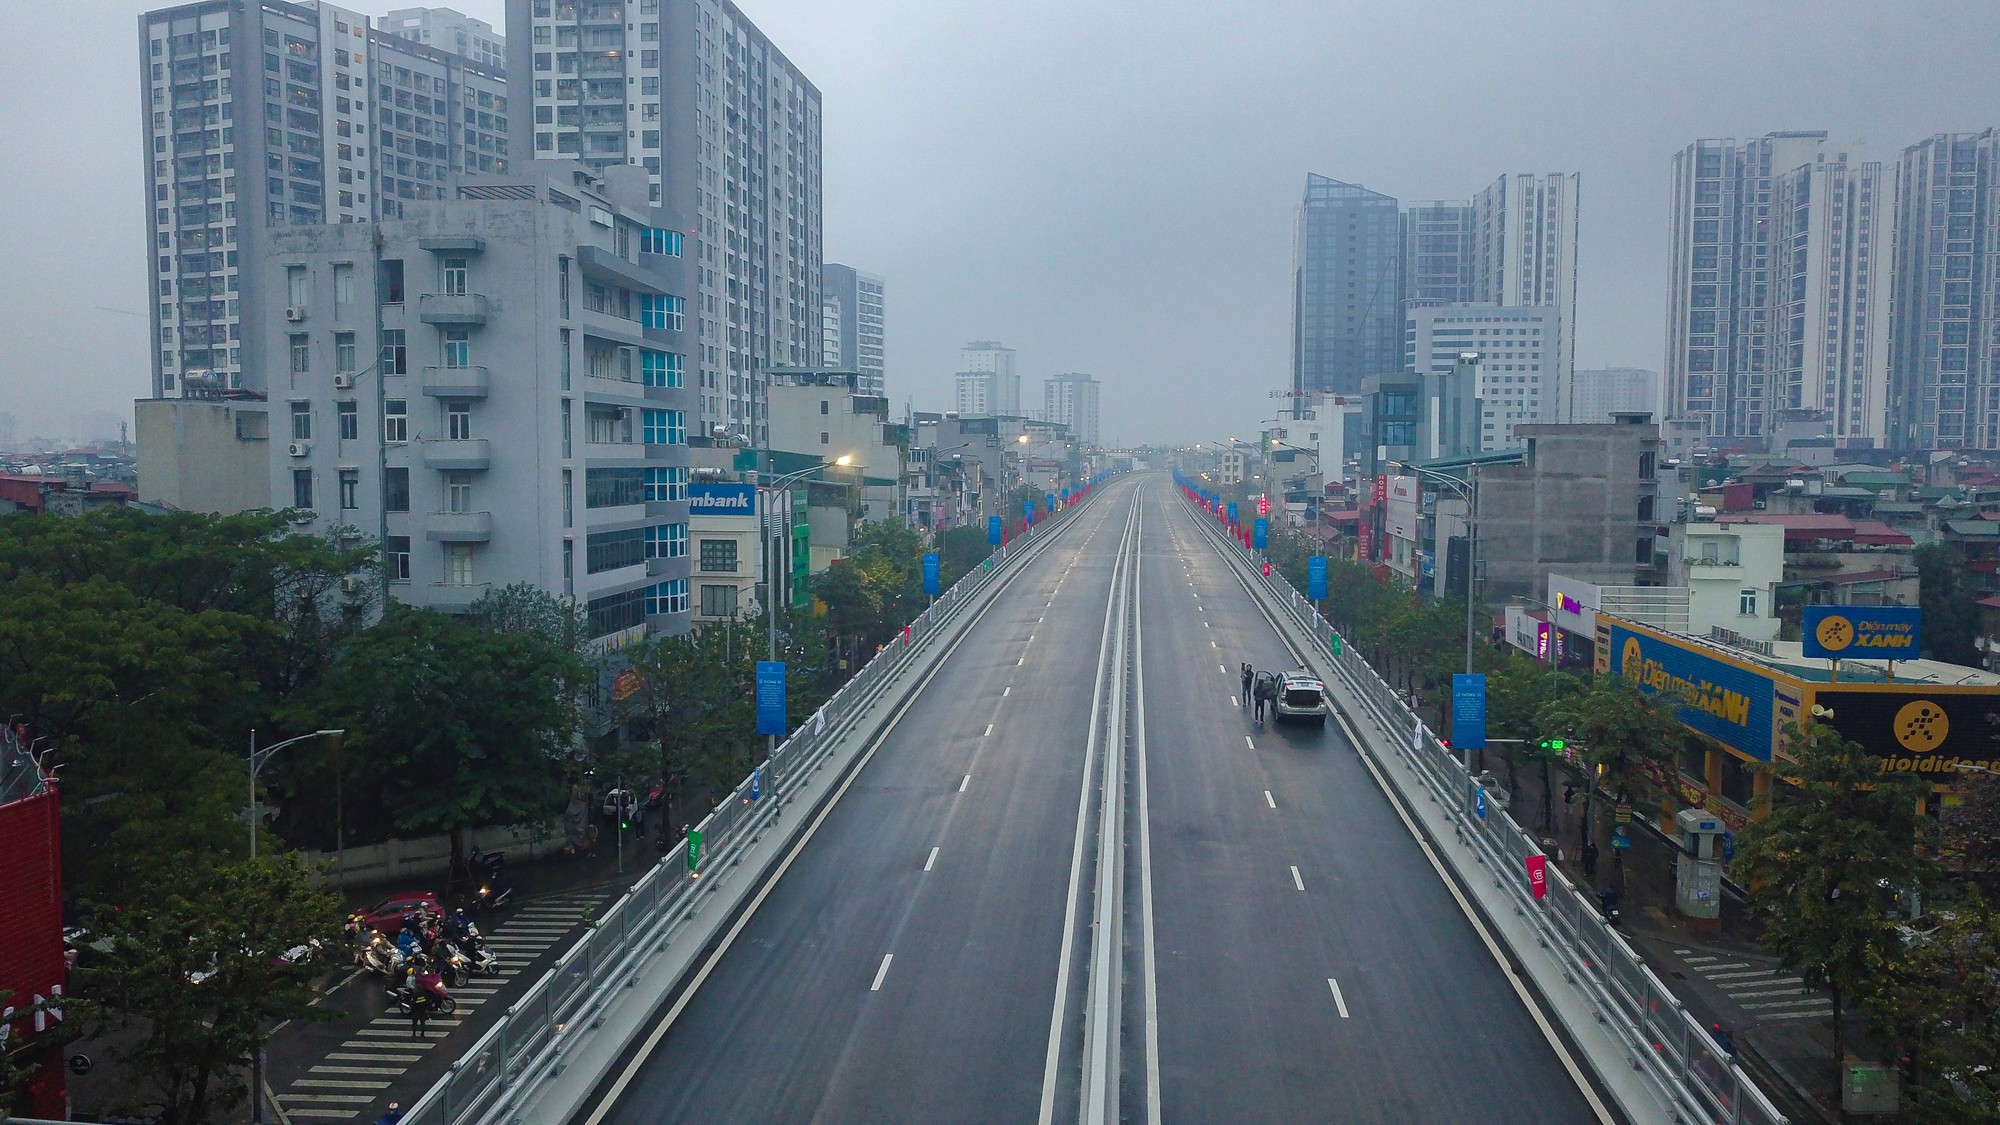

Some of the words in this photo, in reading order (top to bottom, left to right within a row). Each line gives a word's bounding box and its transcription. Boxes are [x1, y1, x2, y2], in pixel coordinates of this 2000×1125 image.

[689, 492, 748, 508] mbank
[1854, 633, 1913, 648] XANH
[1700, 679, 1750, 728] XANH
